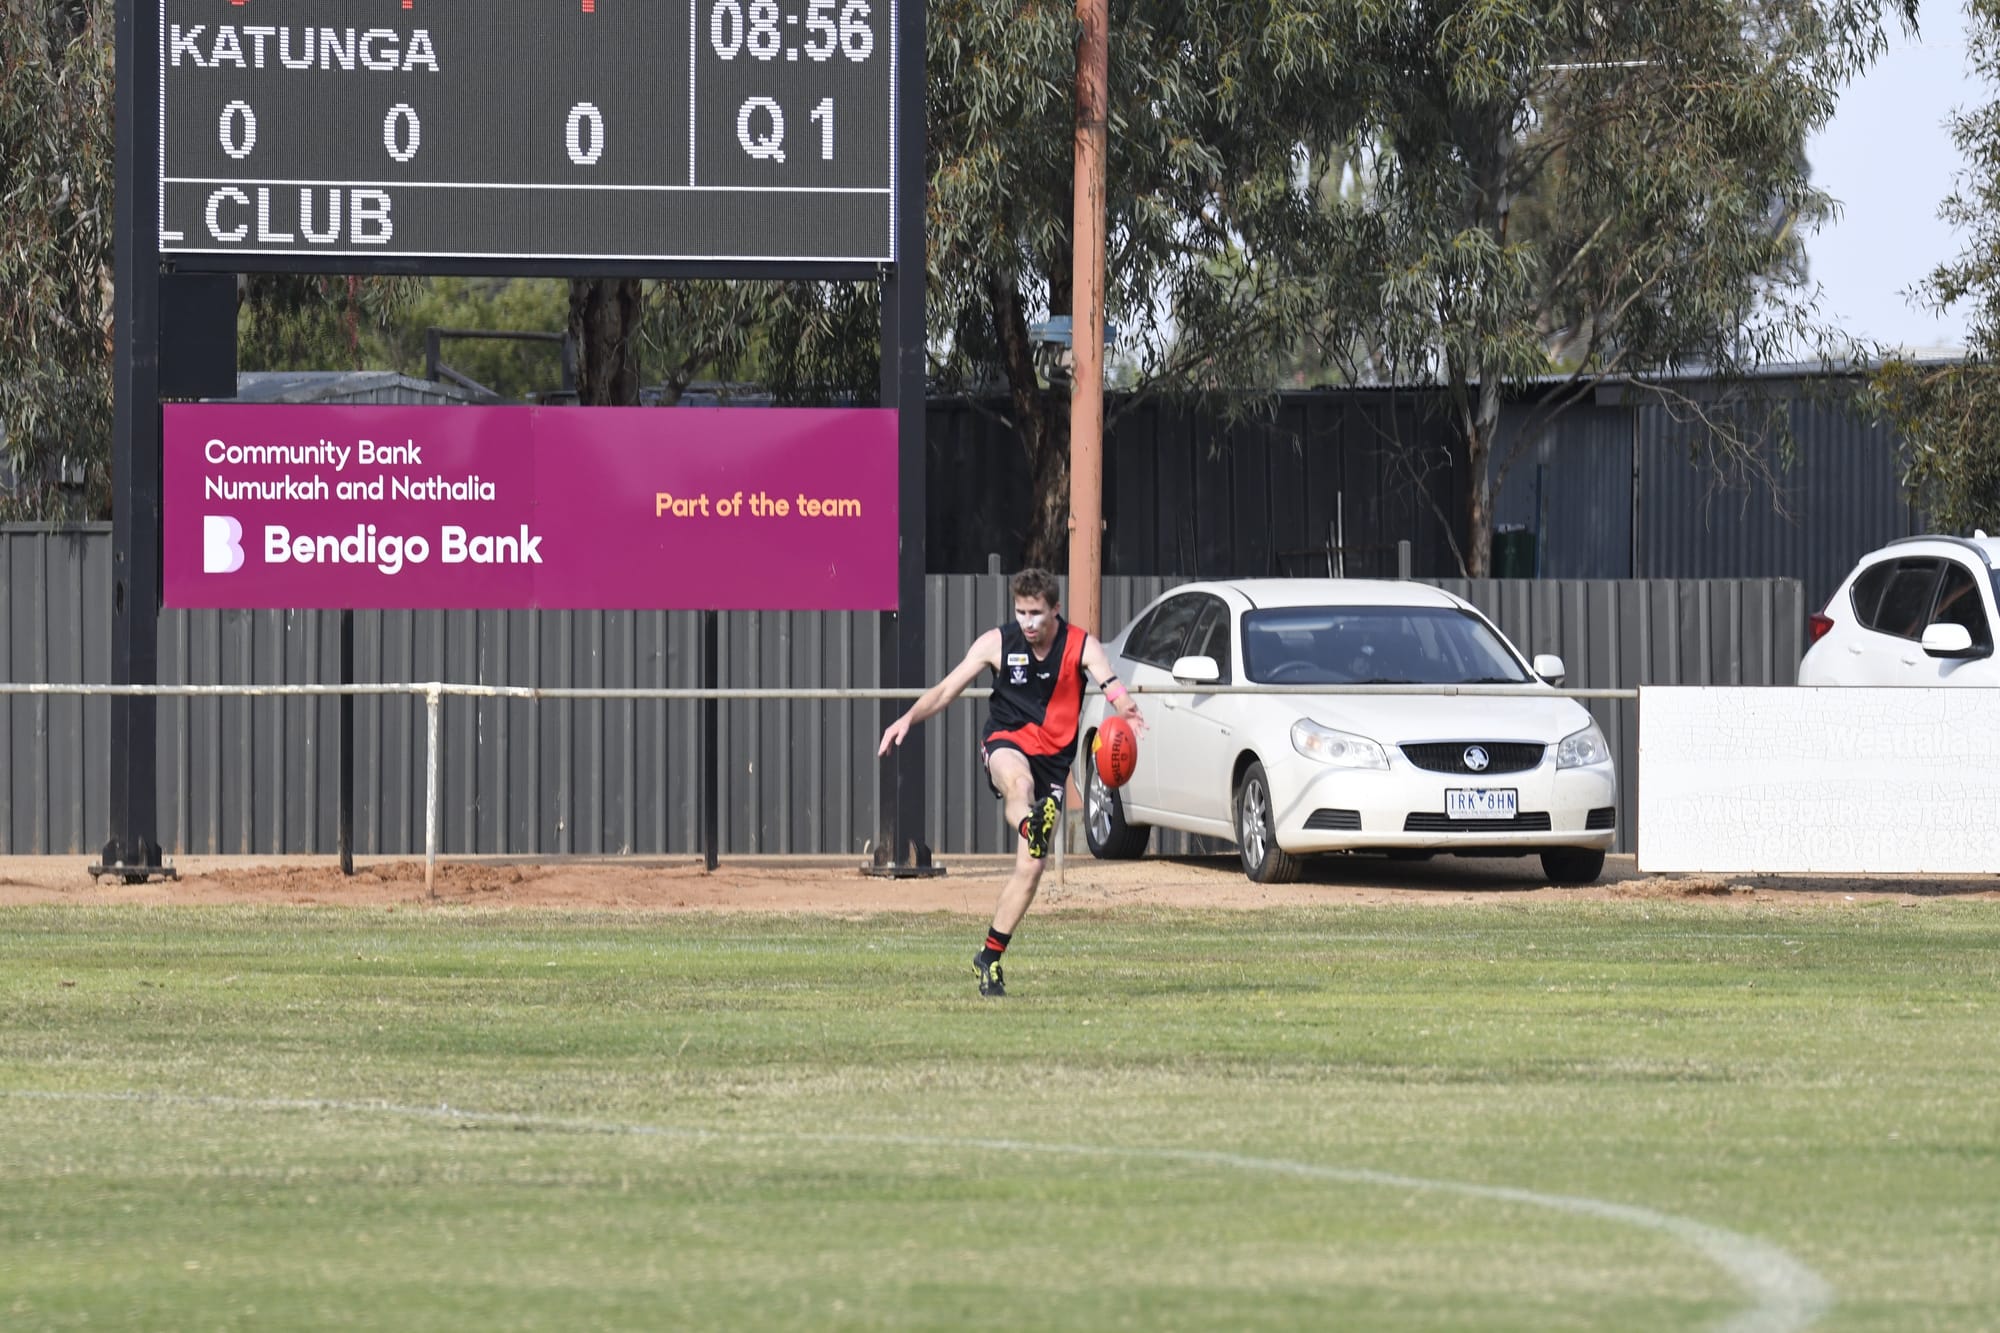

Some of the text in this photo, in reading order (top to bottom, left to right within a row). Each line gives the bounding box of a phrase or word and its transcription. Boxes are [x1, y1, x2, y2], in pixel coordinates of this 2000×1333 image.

[170, 24, 440, 72] KATUNGA
[711, 0, 874, 62] 08:56
[219, 100, 604, 165] 0 0 0
[737, 96, 833, 163] Q 1
[205, 187, 393, 244] CLUB
[204, 439, 422, 472] Community Bank
[204, 475, 496, 501] Numurkah and Nathalia
[656, 491, 862, 517] Part of the team
[264, 524, 543, 575] Bendigo Bank
